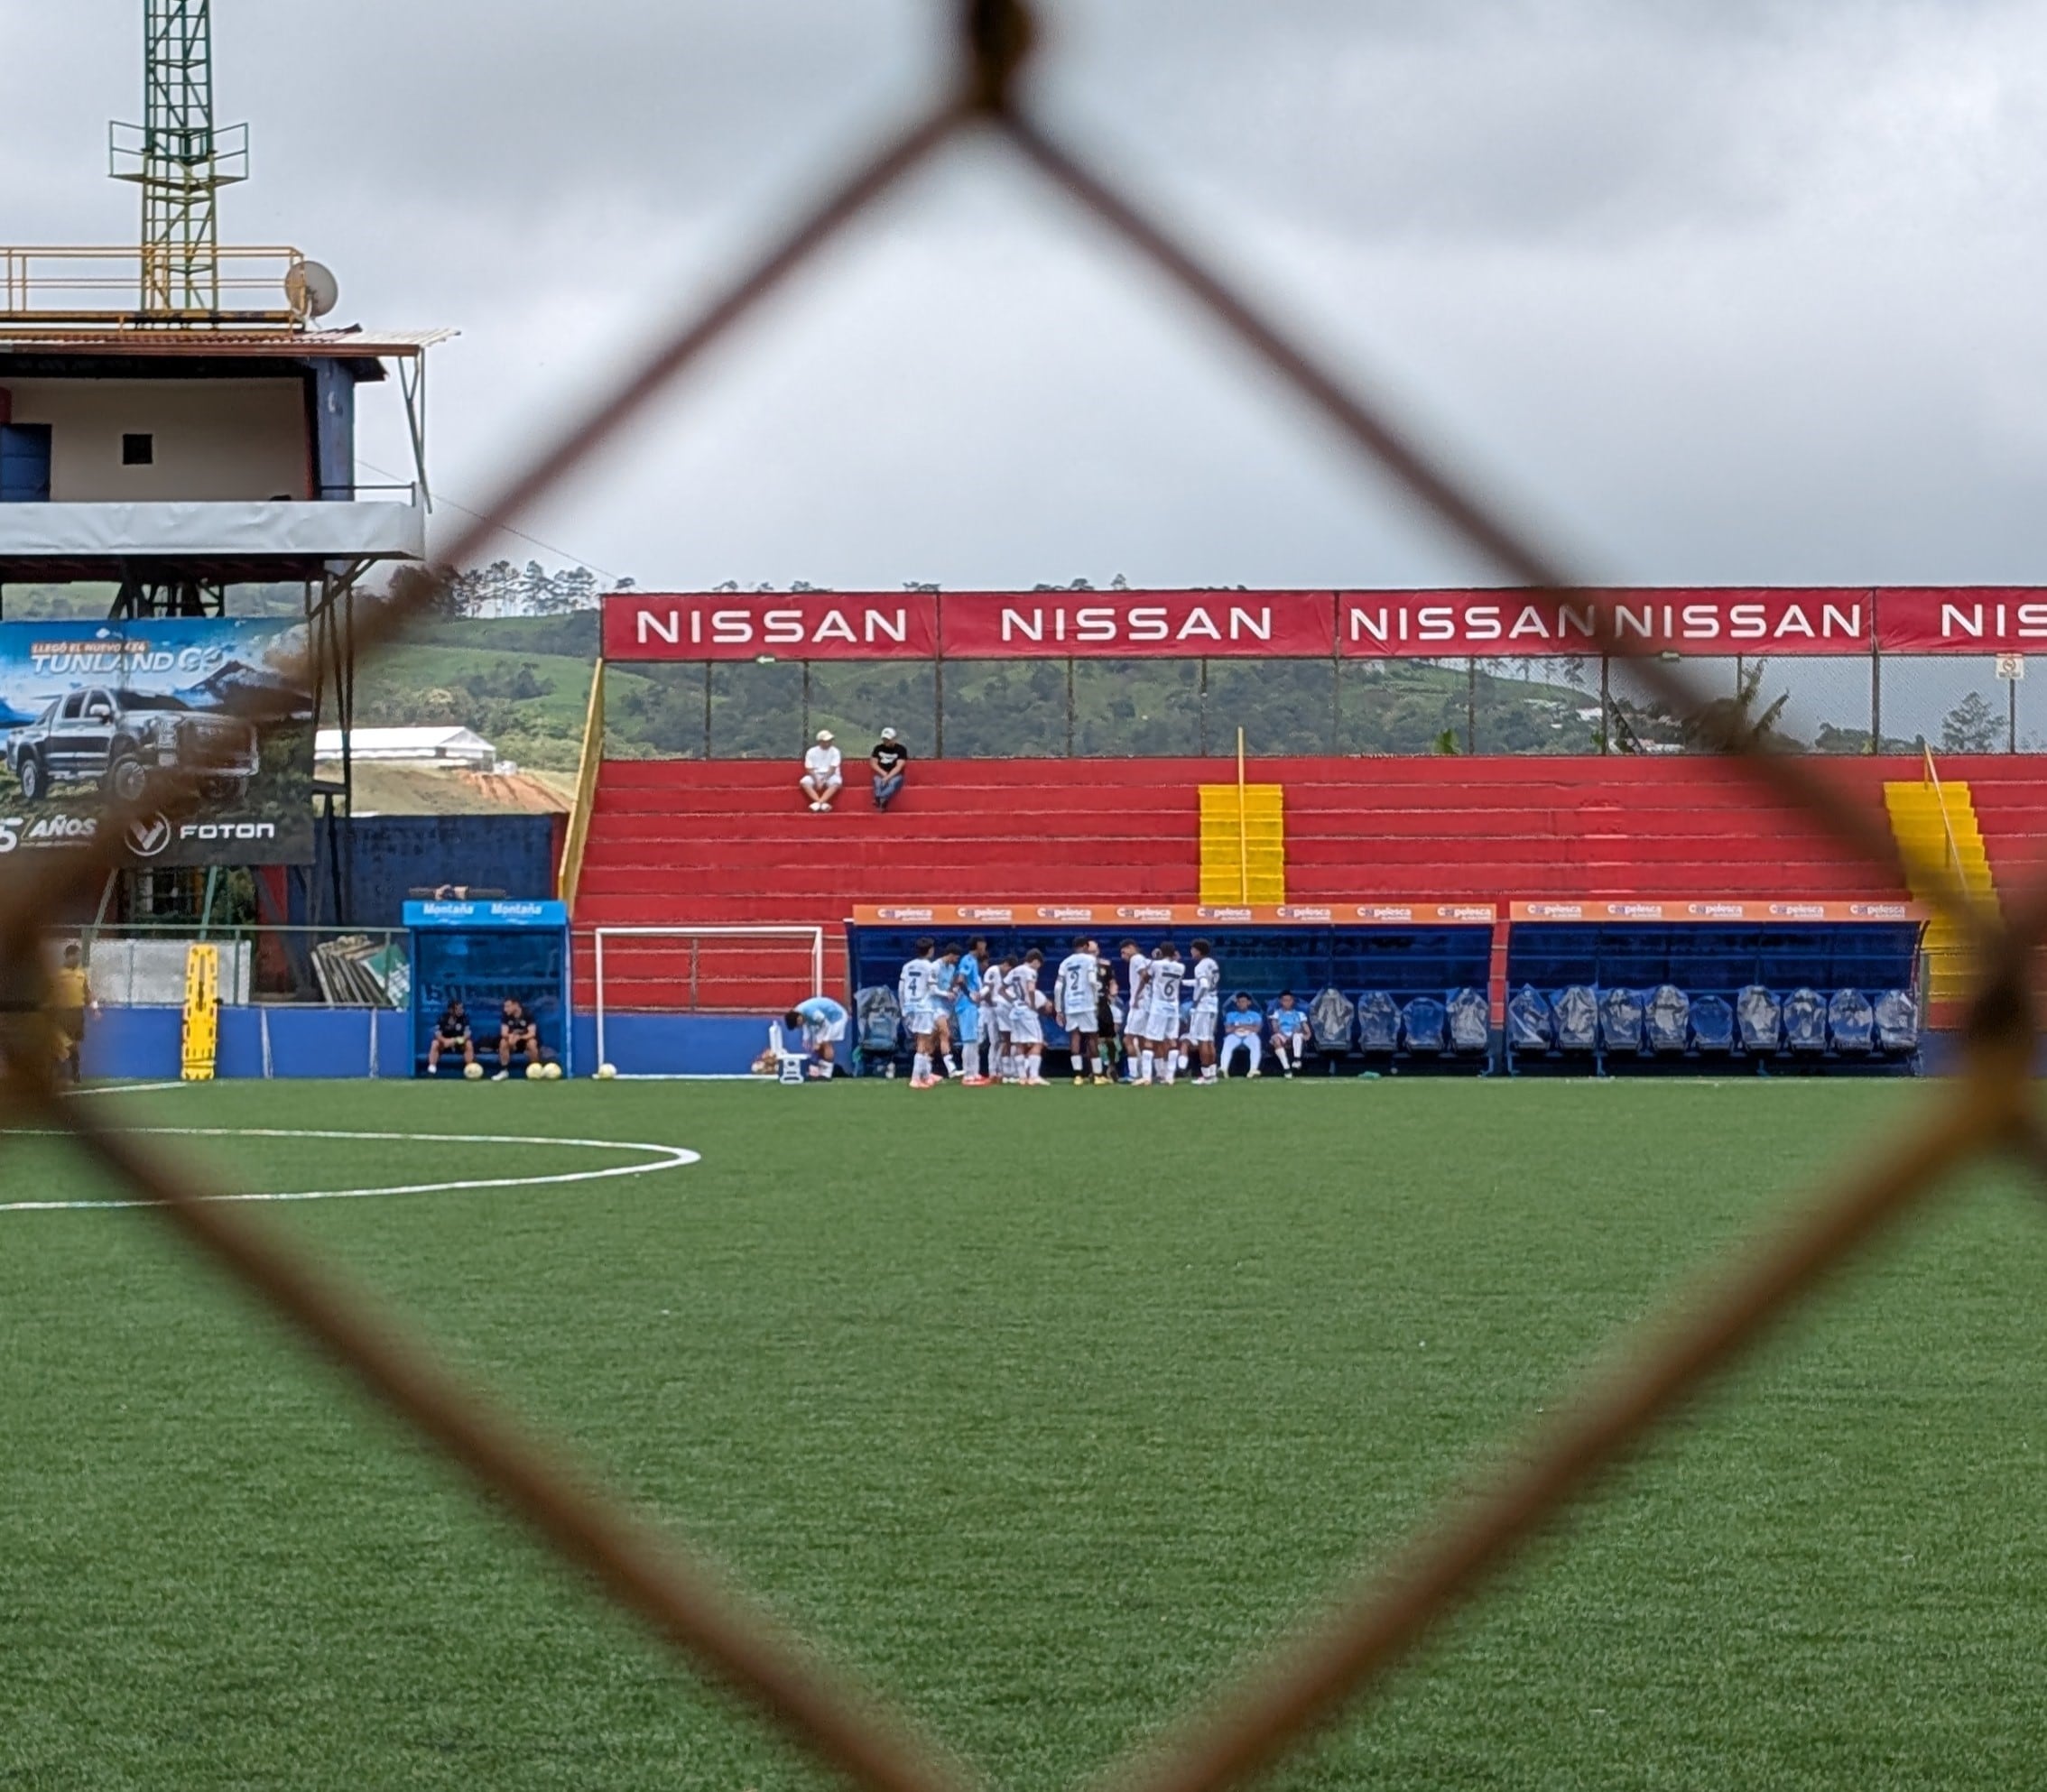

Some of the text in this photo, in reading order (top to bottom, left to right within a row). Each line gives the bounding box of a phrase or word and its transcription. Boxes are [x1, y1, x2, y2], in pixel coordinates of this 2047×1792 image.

[637, 609, 906, 643] NISSAN
[1002, 606, 1271, 642] NISSAN
[1350, 605, 1597, 641] NISSAN
[1615, 604, 1861, 639] NISSAN
[32, 652, 174, 673] TUNLAND
[29, 814, 97, 837] AÑOS
[181, 823, 274, 839] FOTON
[907, 977, 917, 997] 4
[1070, 971, 1079, 991] 2
[1162, 978, 1174, 997] 6
